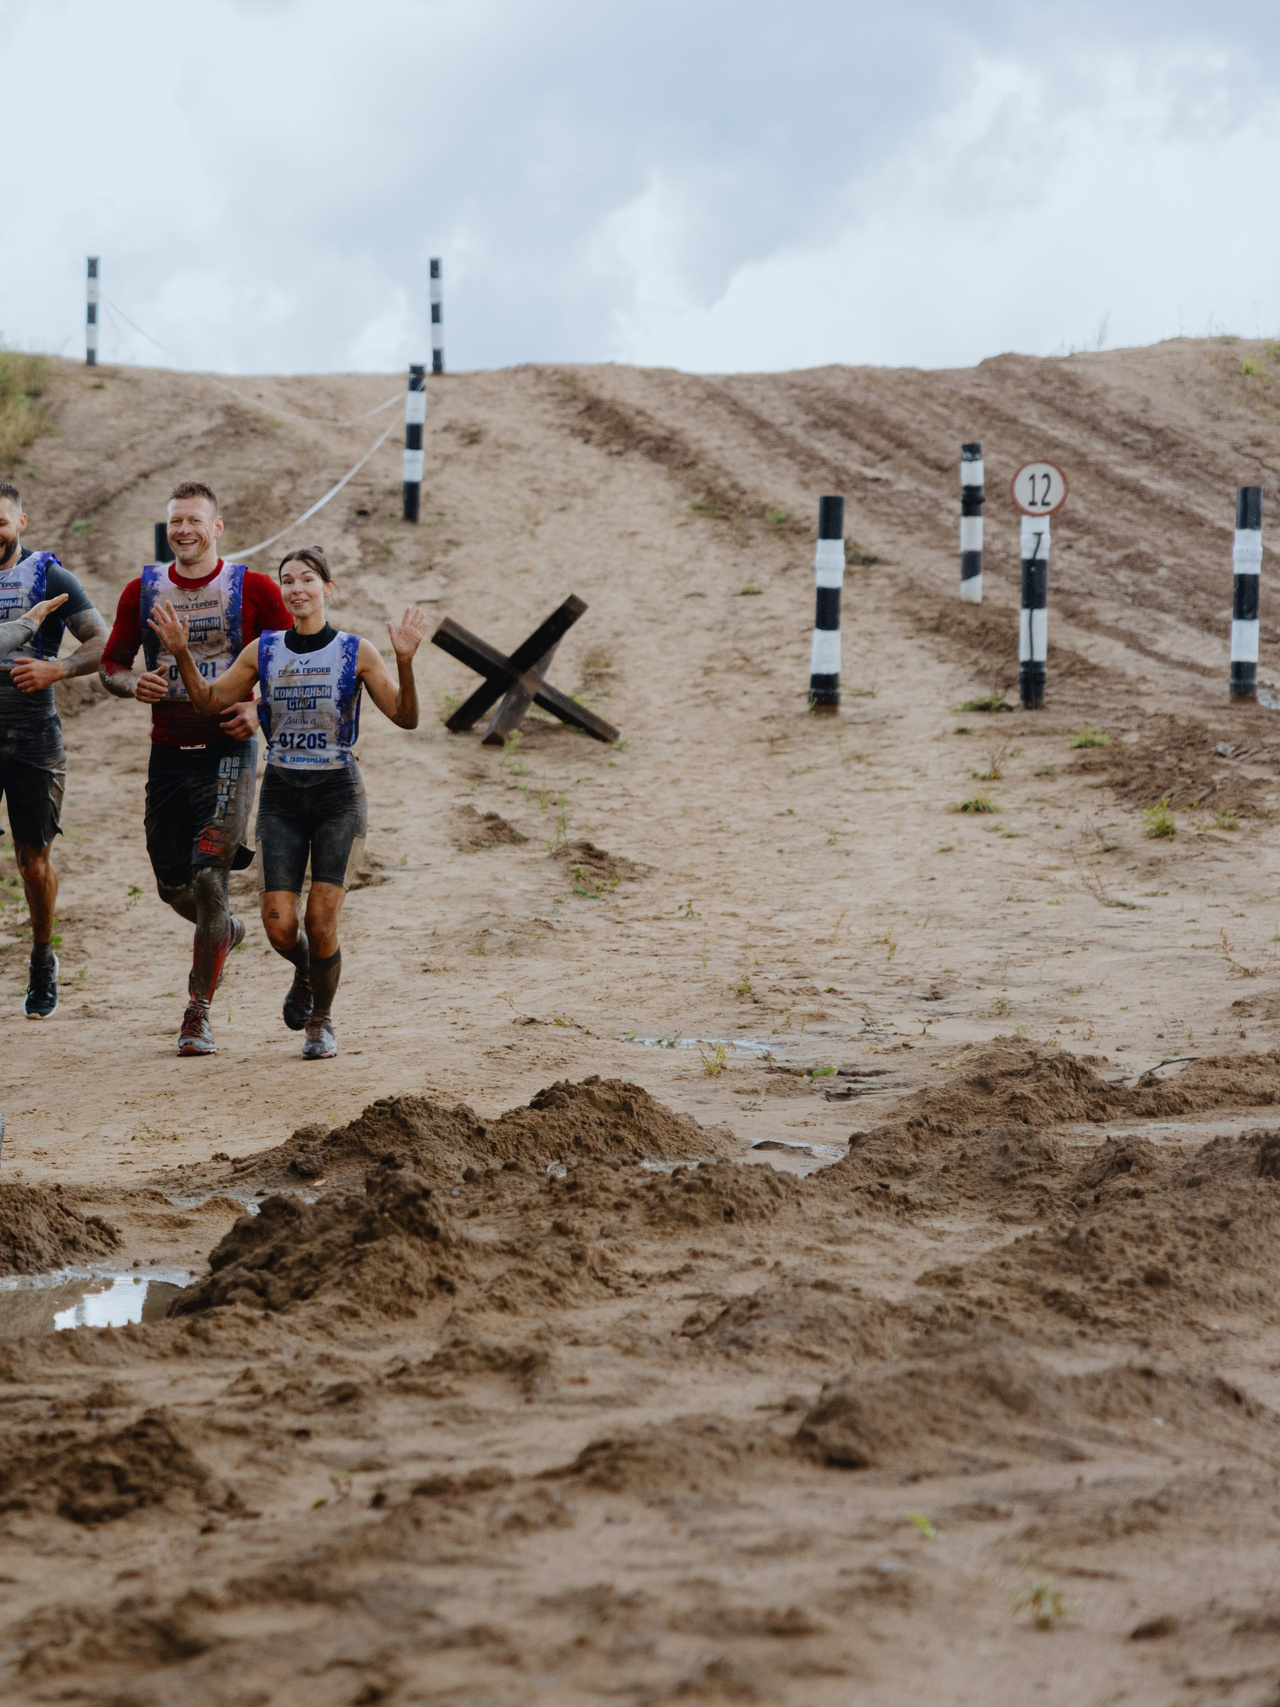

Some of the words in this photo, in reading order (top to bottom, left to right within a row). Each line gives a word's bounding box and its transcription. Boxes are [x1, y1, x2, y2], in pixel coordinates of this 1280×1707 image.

[1027, 473, 1052, 507] 12
[191, 600, 219, 608] ГЕРОЕВ
[190, 631, 205, 641] АРТ
[302, 666, 331, 674] ГЕРОЕВ
[274, 684, 331, 699] КОМАНДНЫЙ
[288, 698, 315, 709] СТАРТ
[278, 732, 328, 750] 01205
[289, 756, 331, 764] ГАЗПРОМБАНК
